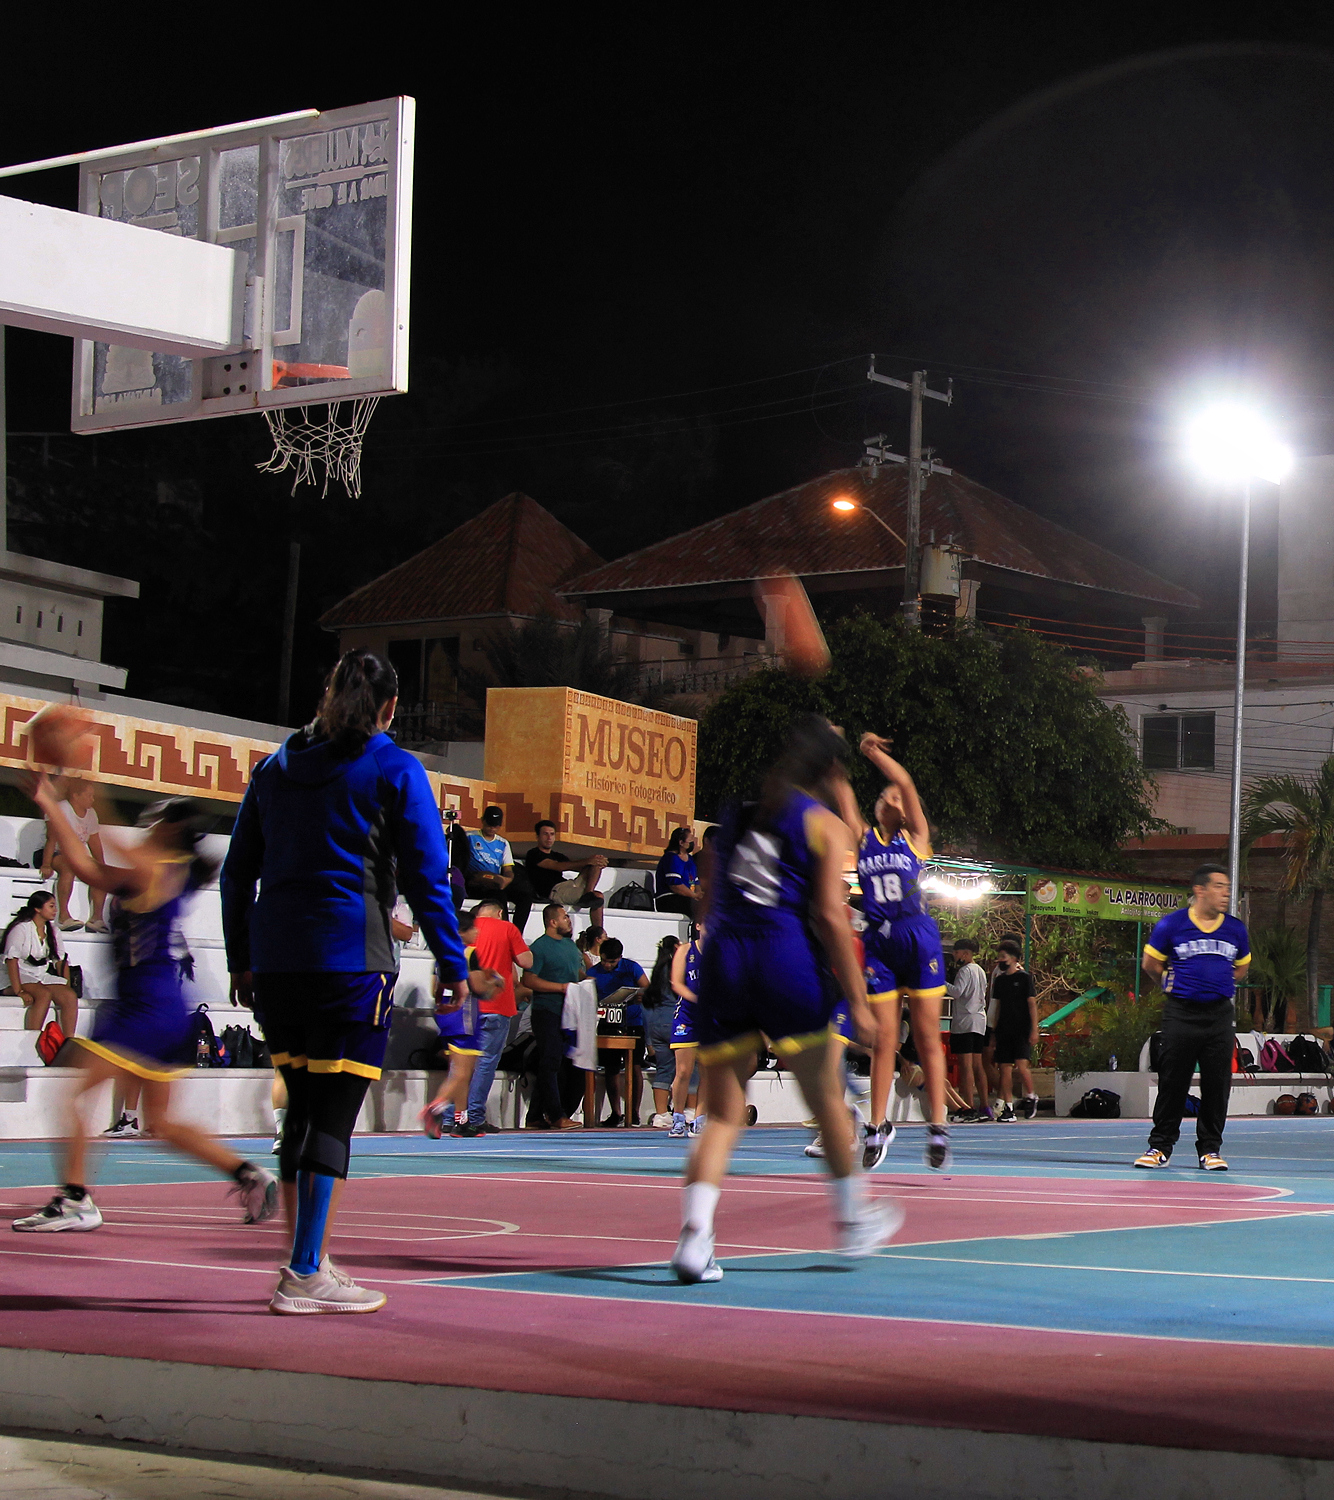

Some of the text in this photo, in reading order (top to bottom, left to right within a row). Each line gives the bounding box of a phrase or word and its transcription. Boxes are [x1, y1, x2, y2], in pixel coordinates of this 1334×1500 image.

[576, 714, 687, 782] MUSEO
[586, 771, 676, 804] Histórico Fotográfico
[858, 853, 913, 877] MARLINS
[870, 873, 903, 903] 18
